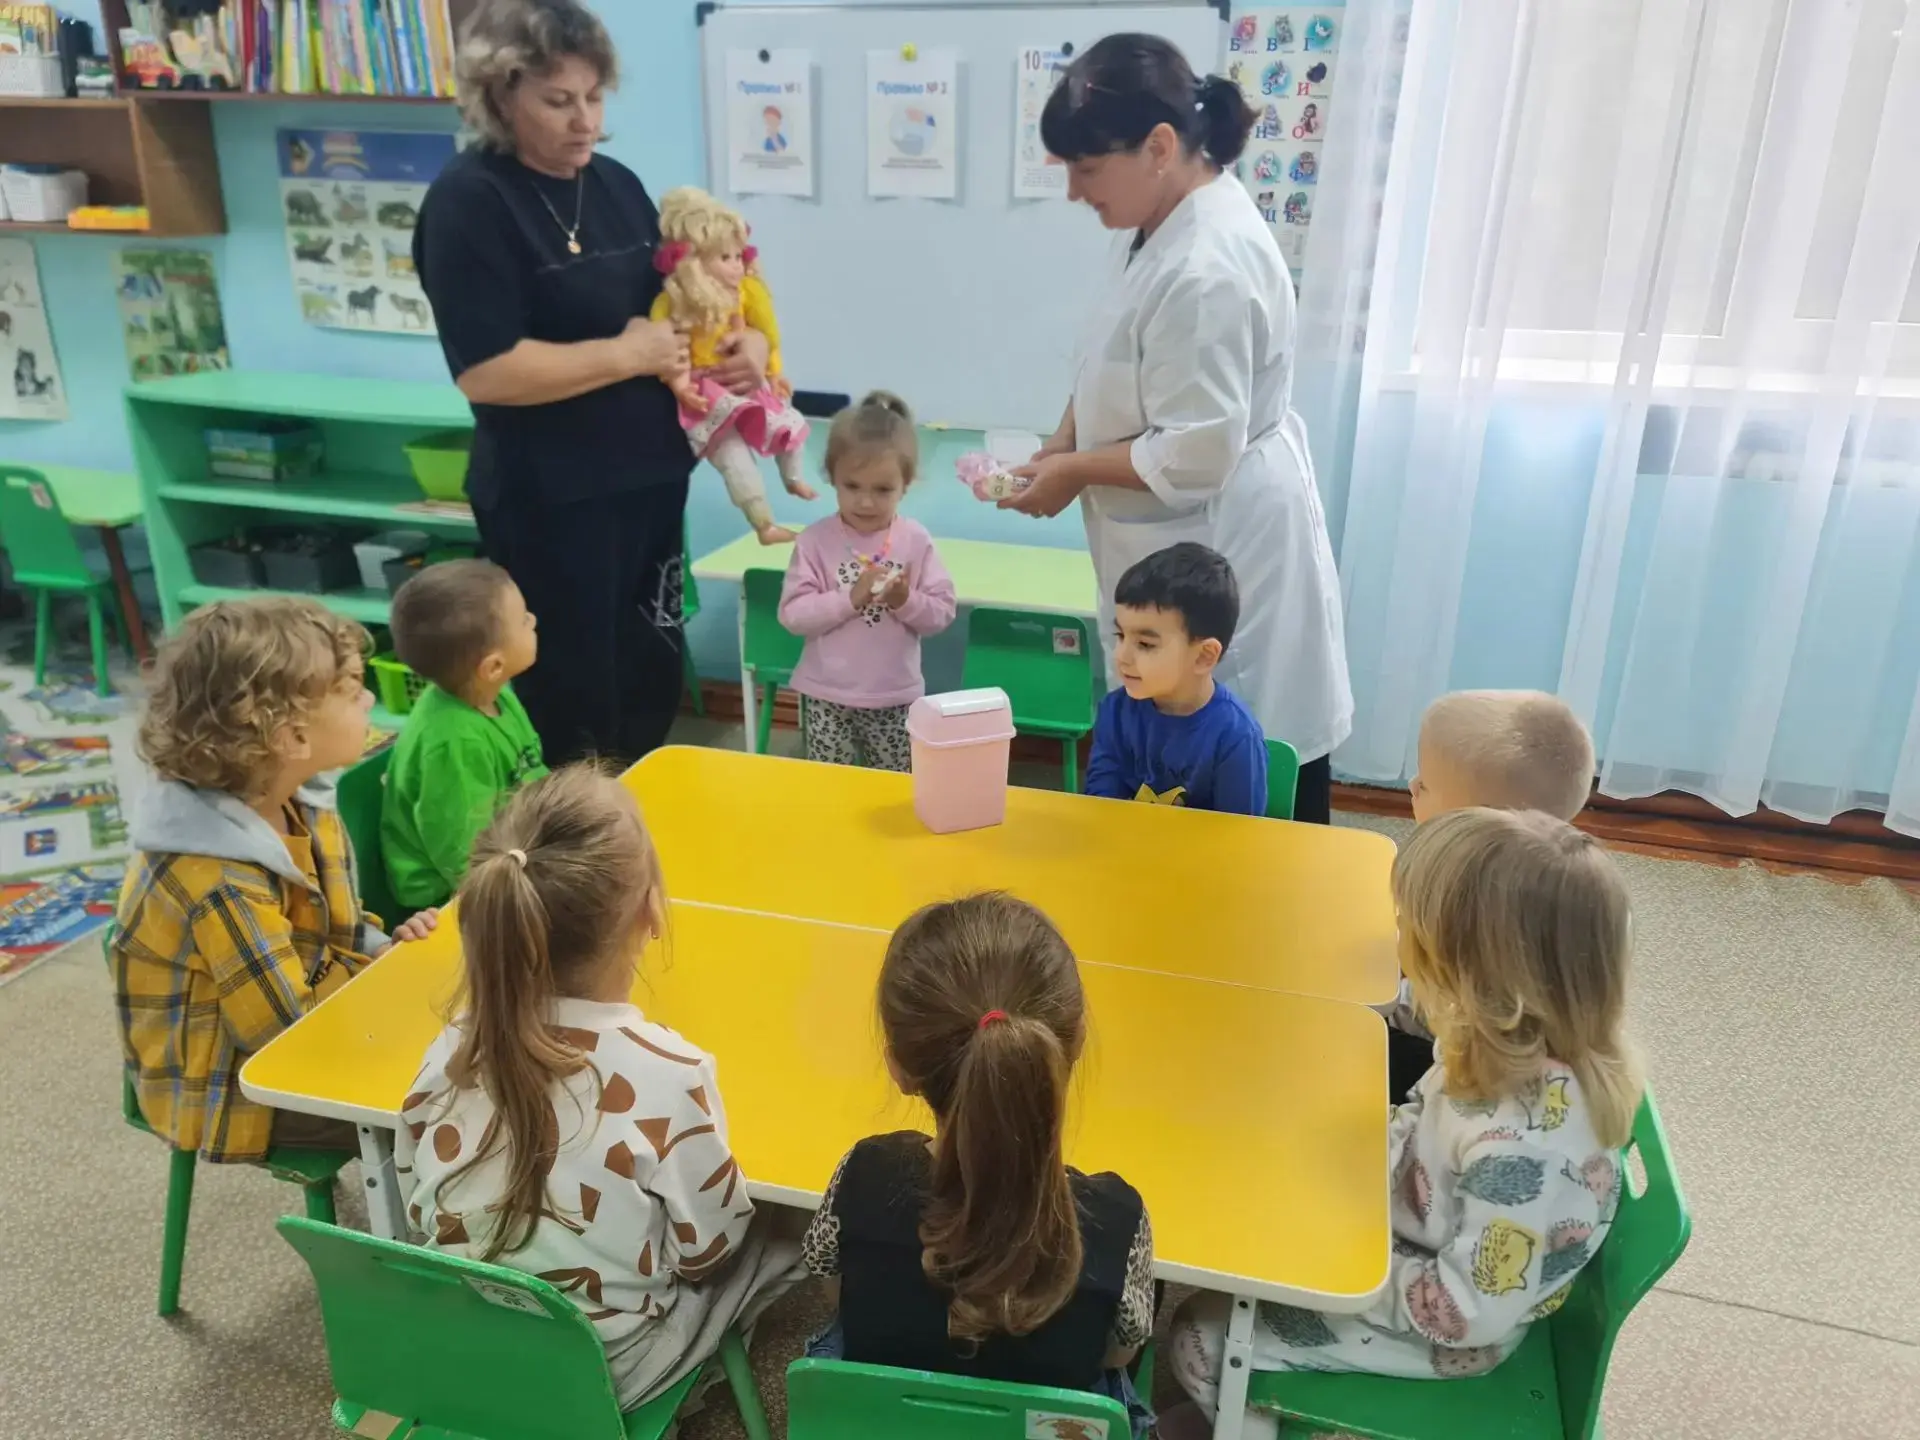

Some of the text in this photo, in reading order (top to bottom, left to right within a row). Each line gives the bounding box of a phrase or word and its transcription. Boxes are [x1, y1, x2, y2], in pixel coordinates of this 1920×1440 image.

[1230, 37, 1315, 52] Б В Г
[1024, 50, 1041, 70] 10
[877, 81, 924, 96] Правило
[1262, 82, 1311, 96] З И
[1255, 125, 1305, 139] Н О
[1289, 168, 1304, 181] Ф
